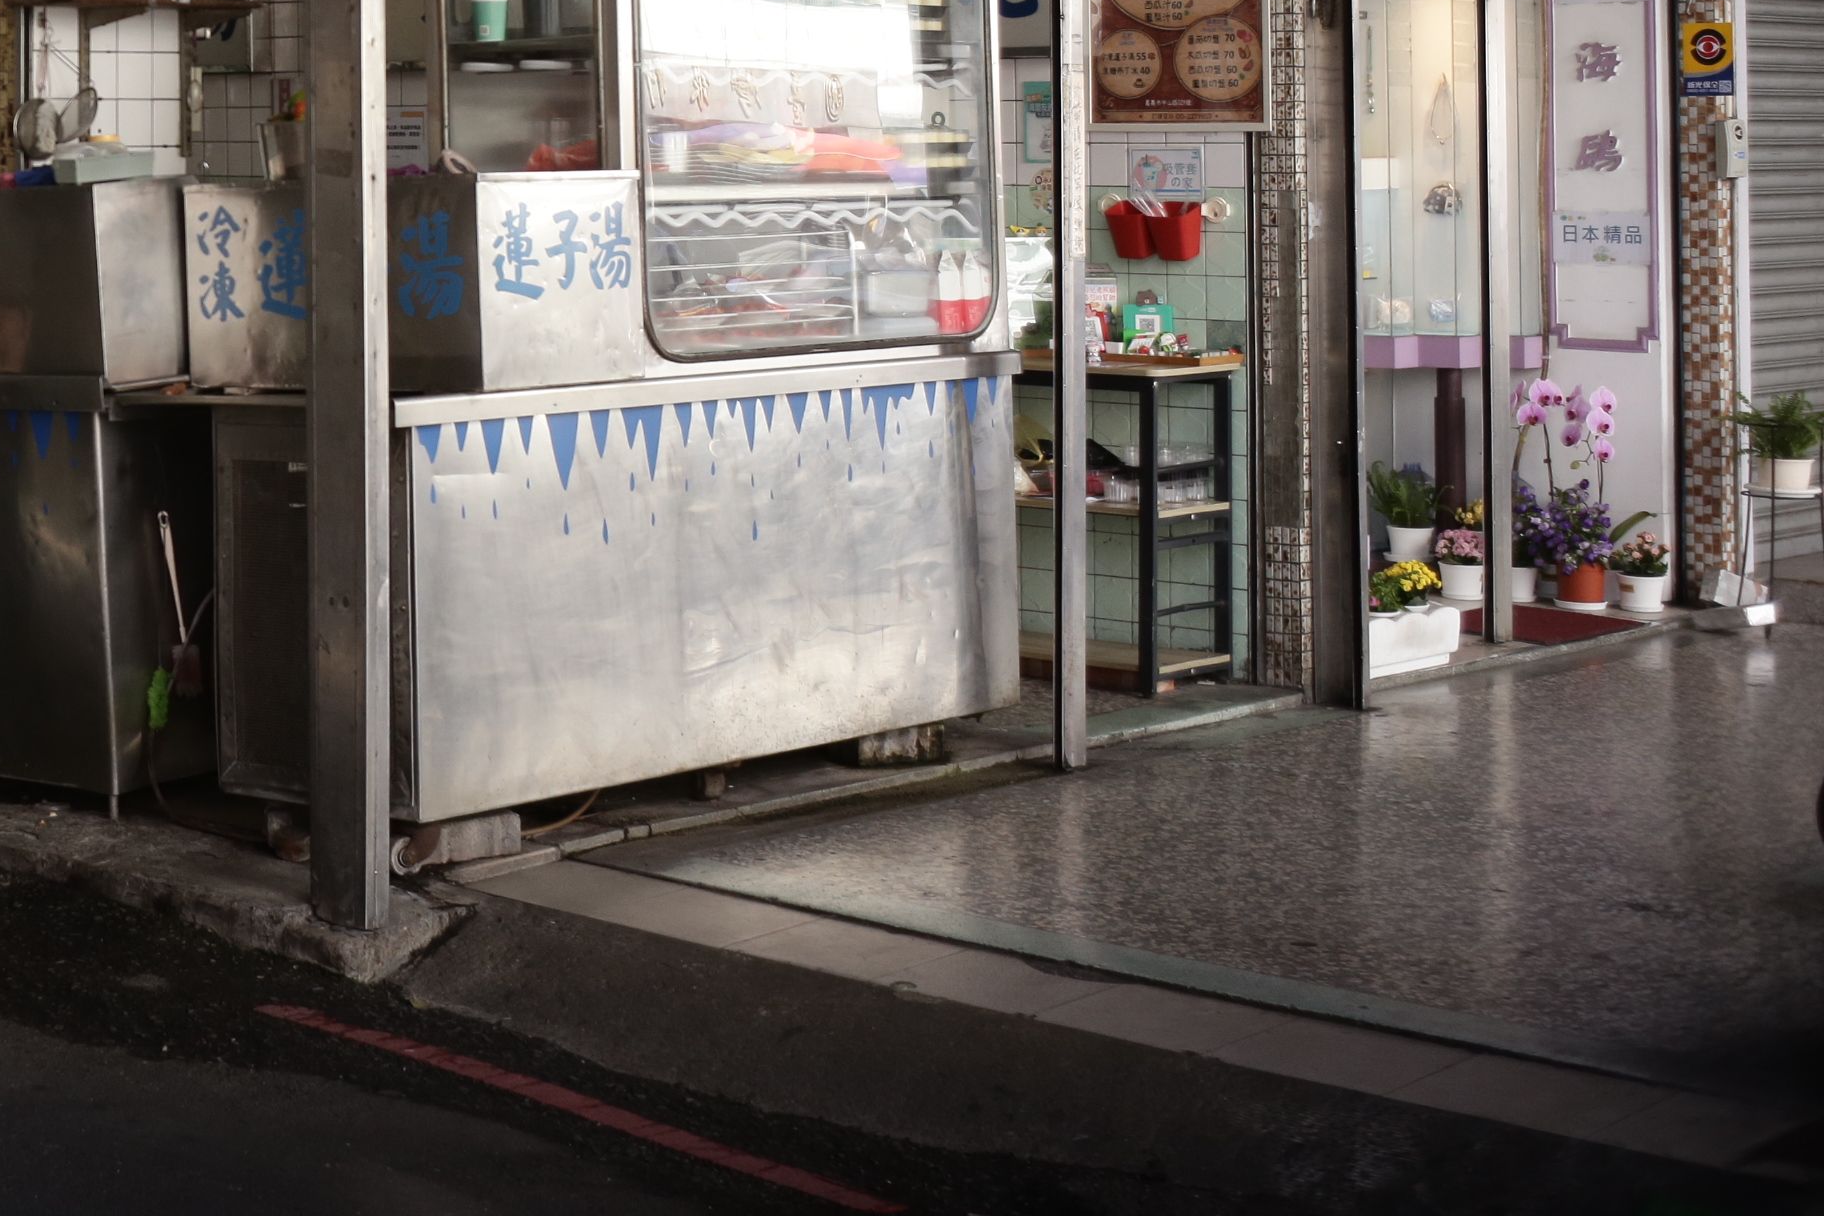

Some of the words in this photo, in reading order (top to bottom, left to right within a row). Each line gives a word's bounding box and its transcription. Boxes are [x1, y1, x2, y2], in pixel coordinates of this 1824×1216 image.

[196, 205, 245, 322] 冷凍
[491, 200, 633, 302] 蓮子湯
[1561, 224, 1644, 245] 日本精品
